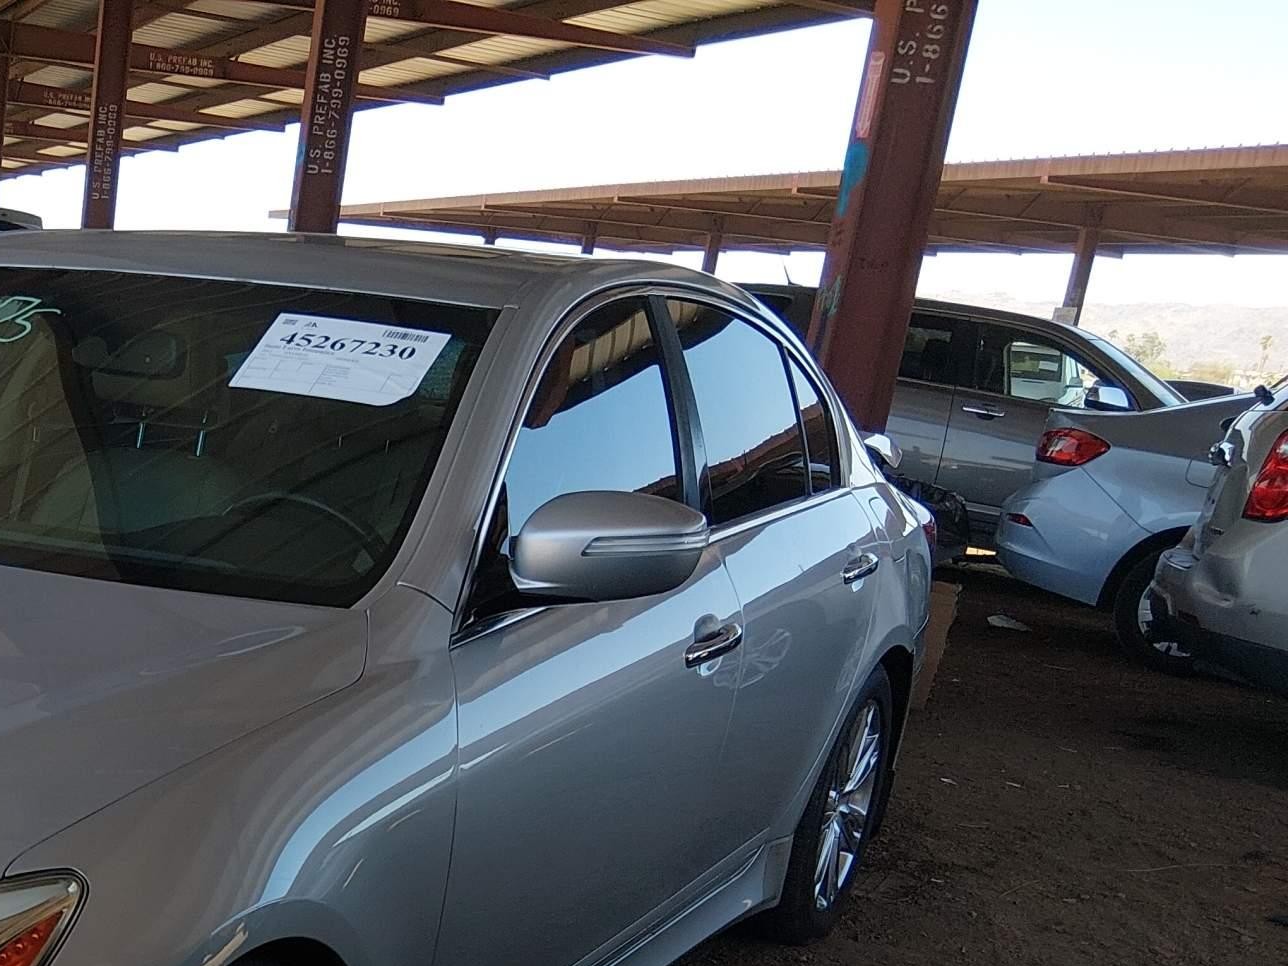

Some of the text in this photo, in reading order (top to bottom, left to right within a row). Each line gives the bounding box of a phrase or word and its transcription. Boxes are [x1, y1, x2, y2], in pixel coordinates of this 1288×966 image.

[307, 34, 338, 174] U.S. PREFAB INC.
[321, 36, 350, 174] 1-866-799-0969
[891, 32, 920, 84] U.S.
[279, 331, 417, 361] 45267230
